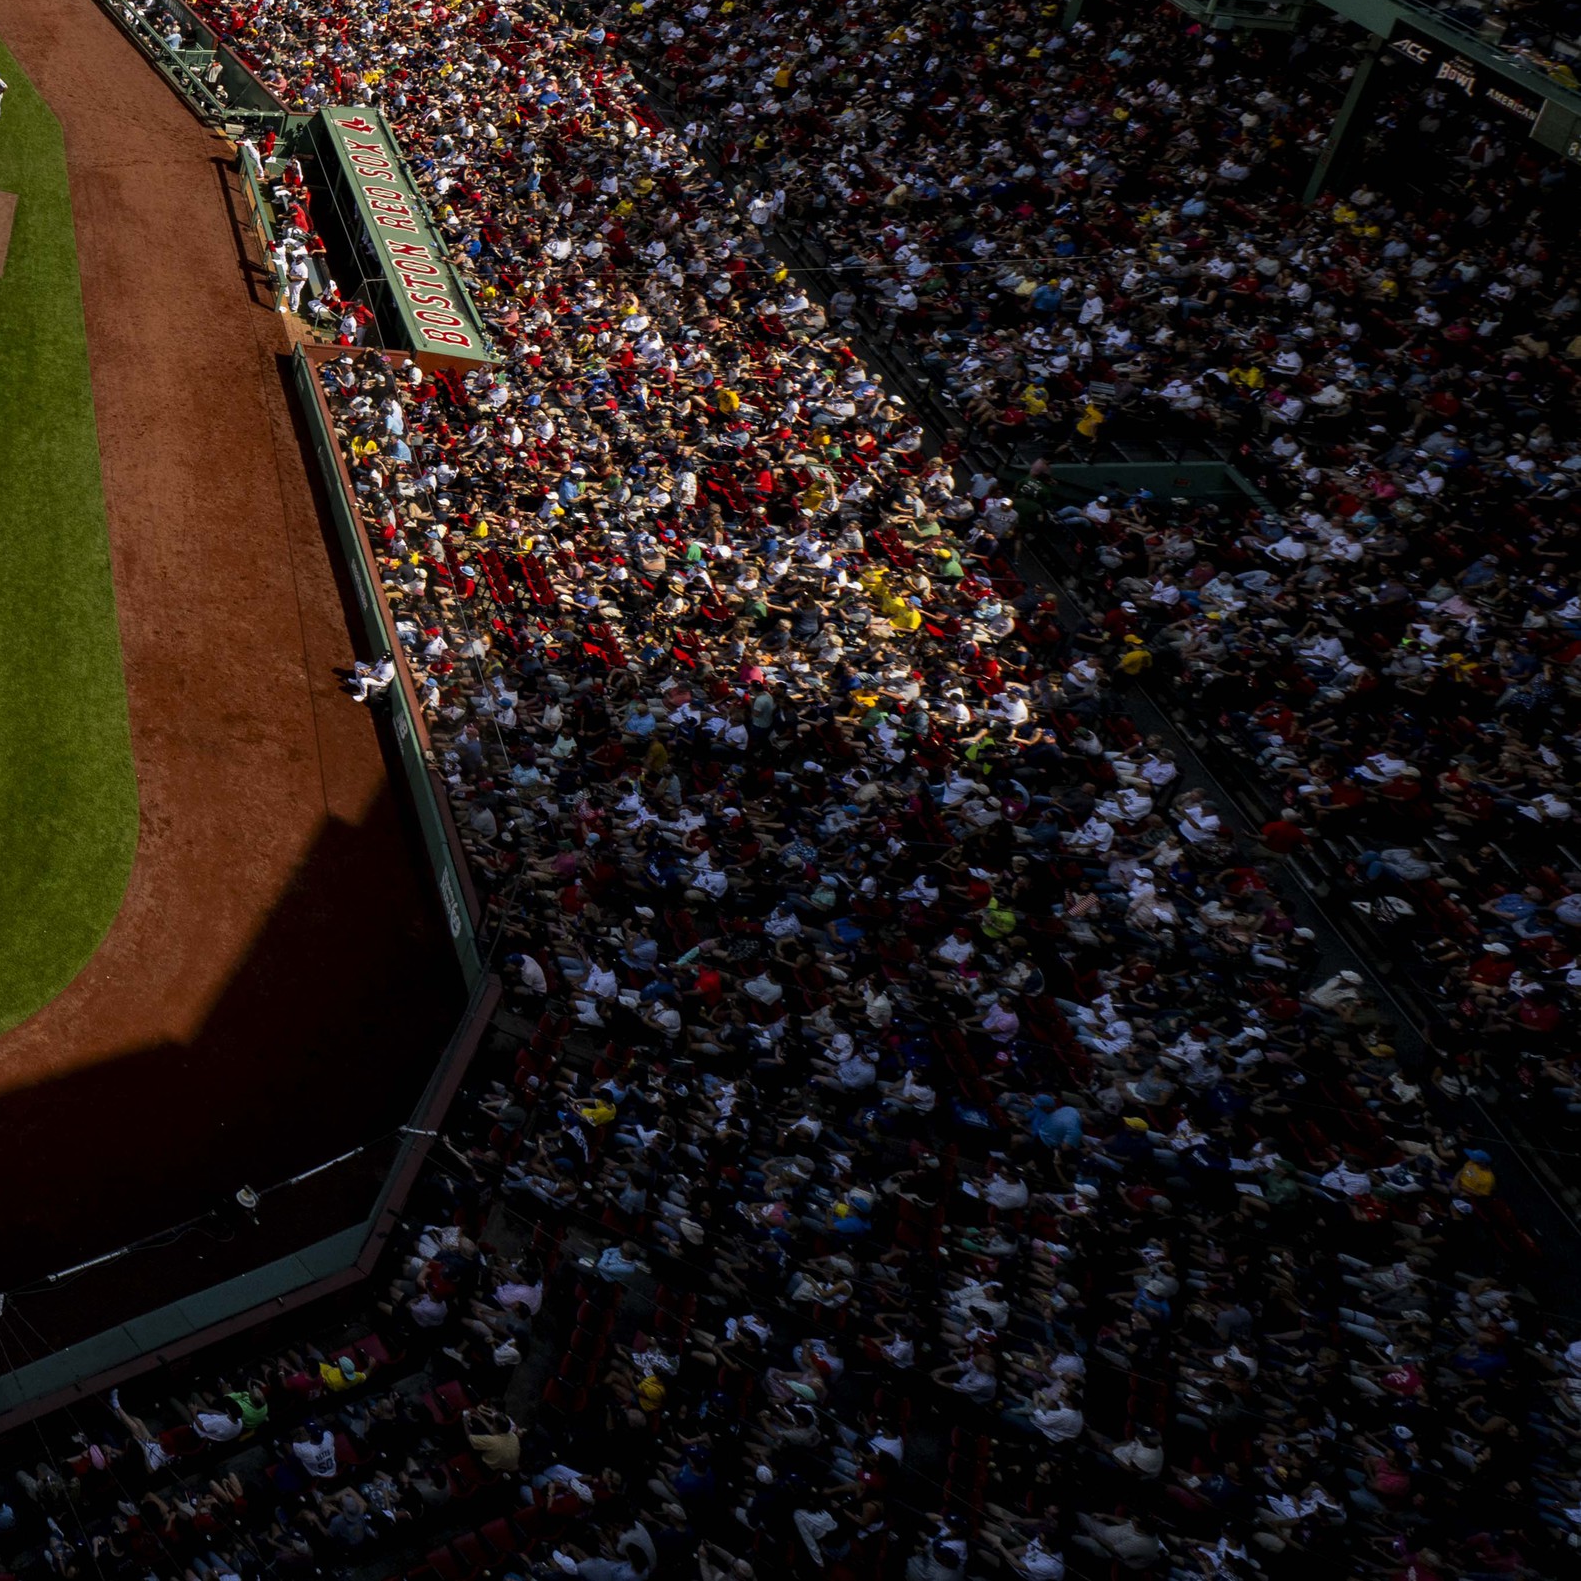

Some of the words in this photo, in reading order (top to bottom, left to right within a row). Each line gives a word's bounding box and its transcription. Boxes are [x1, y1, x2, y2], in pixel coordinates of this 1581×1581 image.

[1393, 39, 1433, 62] ACC
[1485, 88, 1538, 121] AMERICAN
[344, 136, 394, 183] SOX
[362, 185, 419, 234] RED
[385, 238, 473, 349] BOSTON
